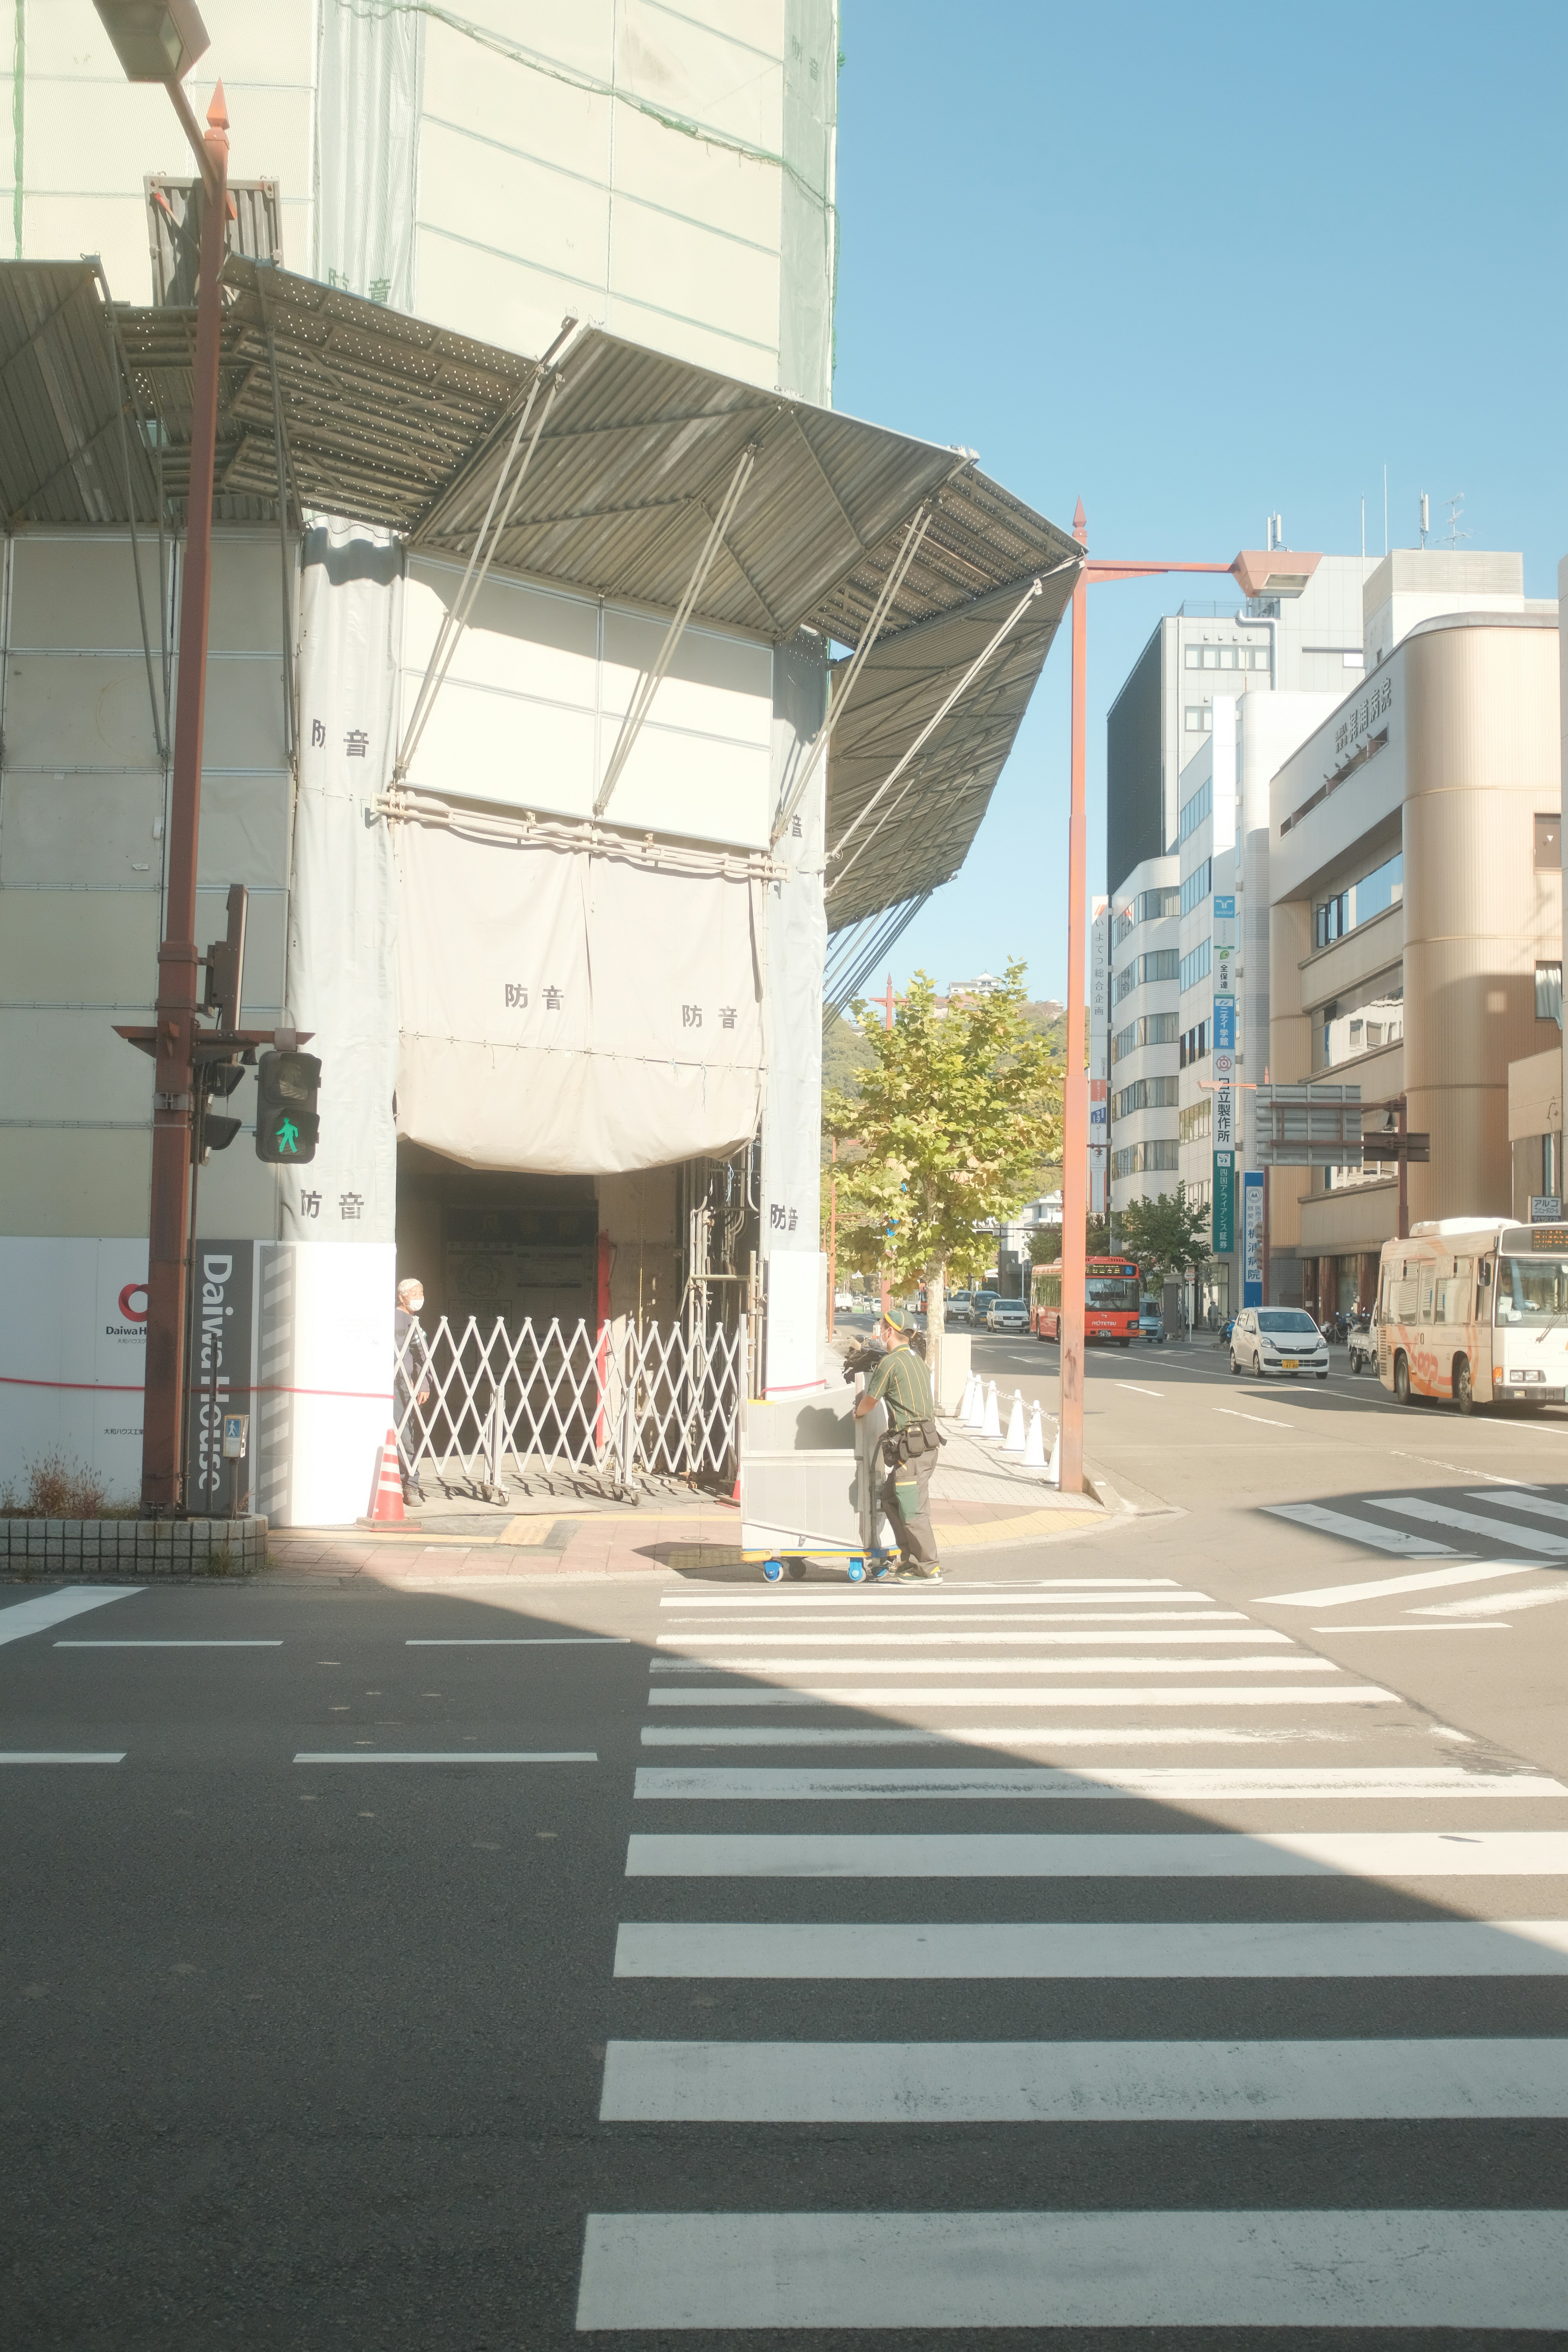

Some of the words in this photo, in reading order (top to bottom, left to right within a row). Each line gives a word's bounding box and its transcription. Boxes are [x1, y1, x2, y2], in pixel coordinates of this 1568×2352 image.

[1349, 677, 1391, 743] 梶浦病院
[1094, 920, 1104, 1015] いよてつ総合企画
[505, 984, 564, 1010] 防音
[682, 1004, 737, 1029] 防音
[1220, 1007, 1228, 1046] ニチイ学館
[301, 1189, 364, 1220] 防音
[771, 1204, 798, 1231] 防音
[201, 1255, 234, 1368] Daiwa
[106, 1326, 138, 1335] Daiwa
[199, 1376, 230, 1491] House
